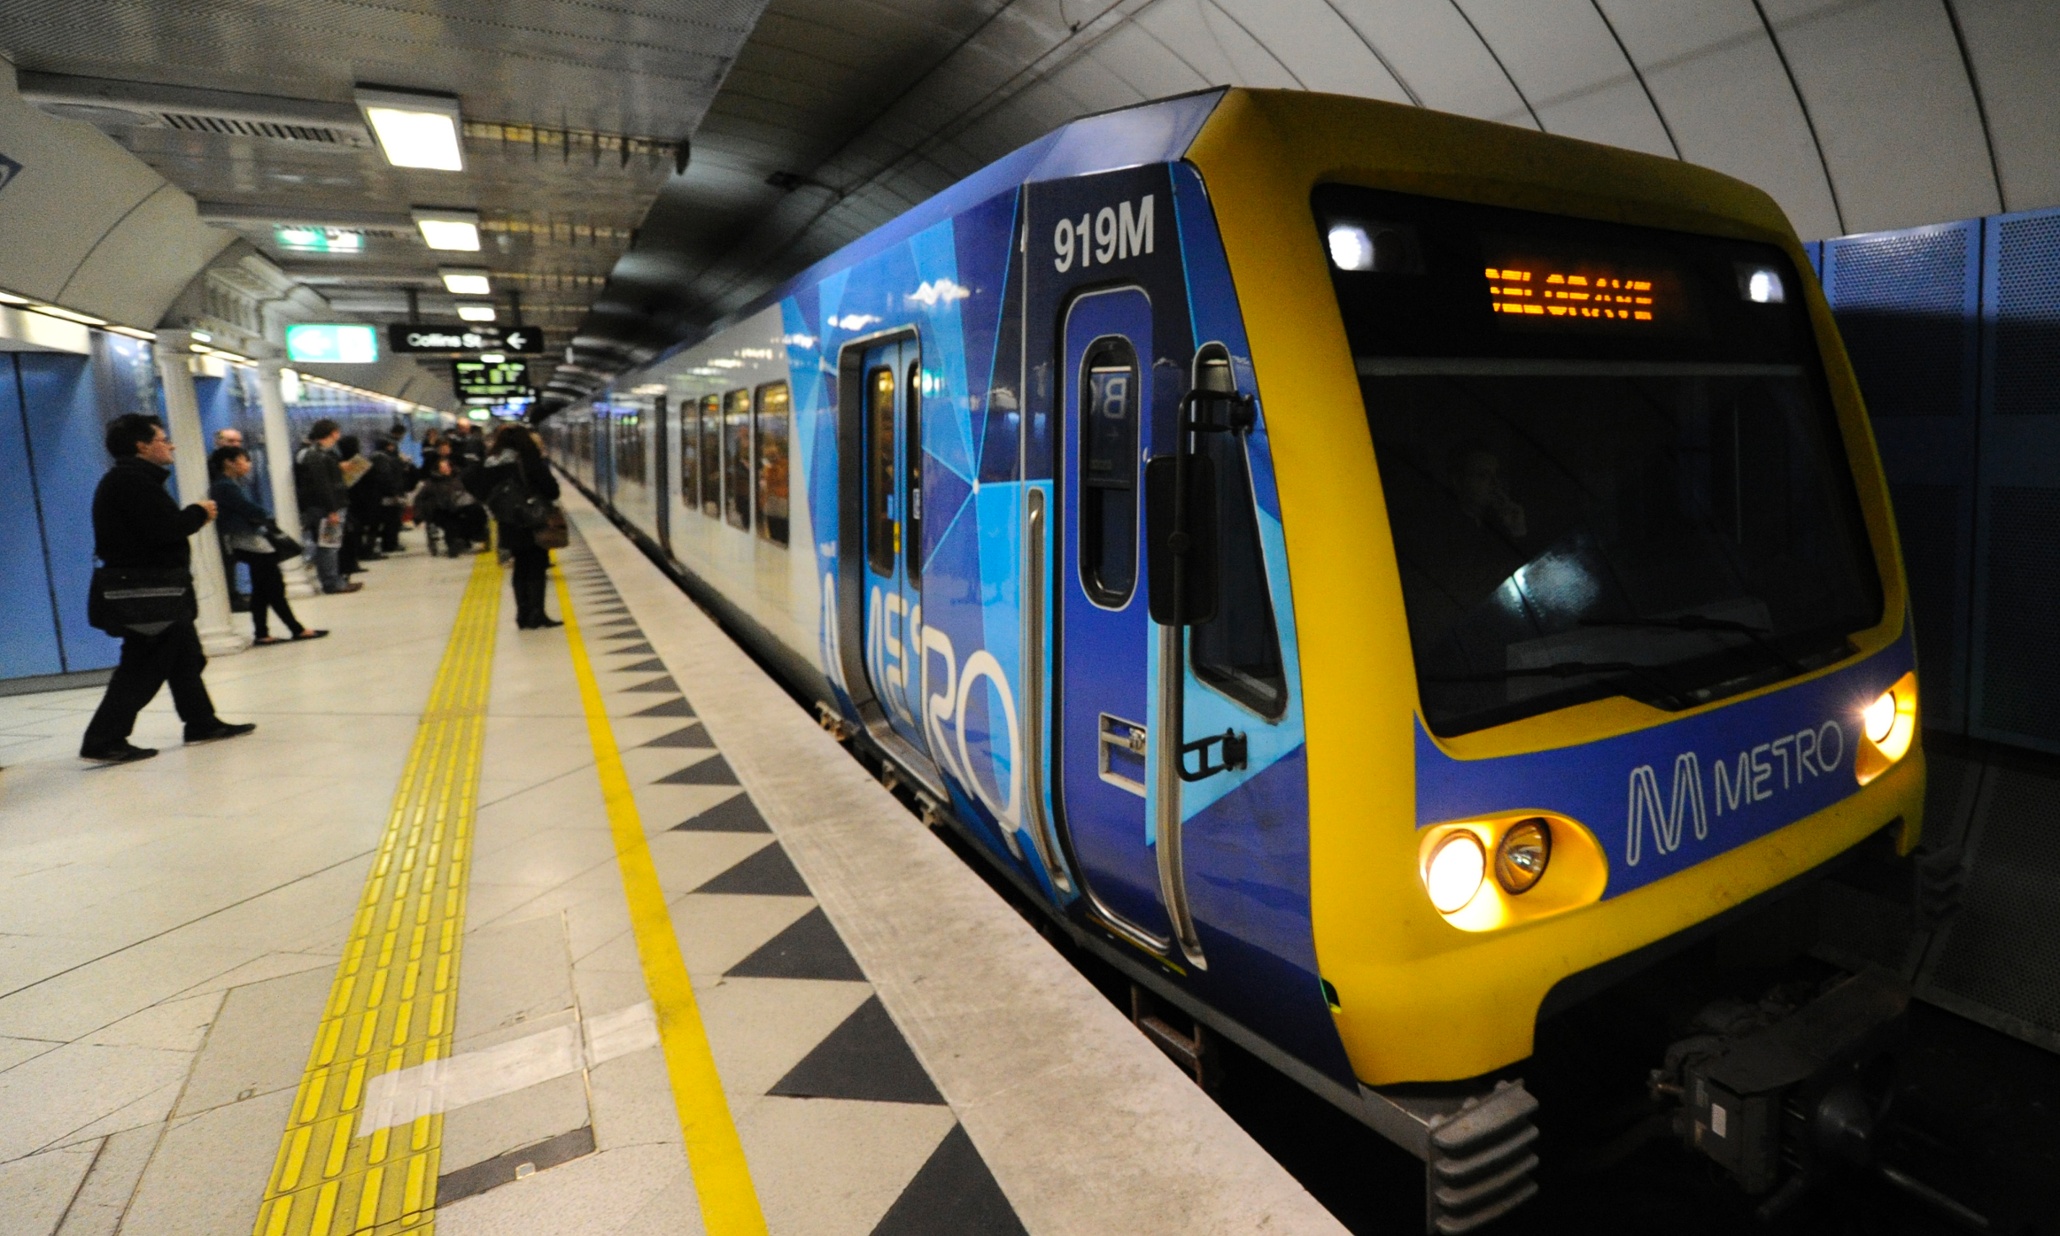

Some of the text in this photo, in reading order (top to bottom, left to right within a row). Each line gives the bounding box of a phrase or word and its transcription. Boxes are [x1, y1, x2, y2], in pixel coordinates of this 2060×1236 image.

[1053, 194, 1154, 273] 919M
[407, 332, 462, 348] Collins
[1715, 720, 1844, 816] METRO
